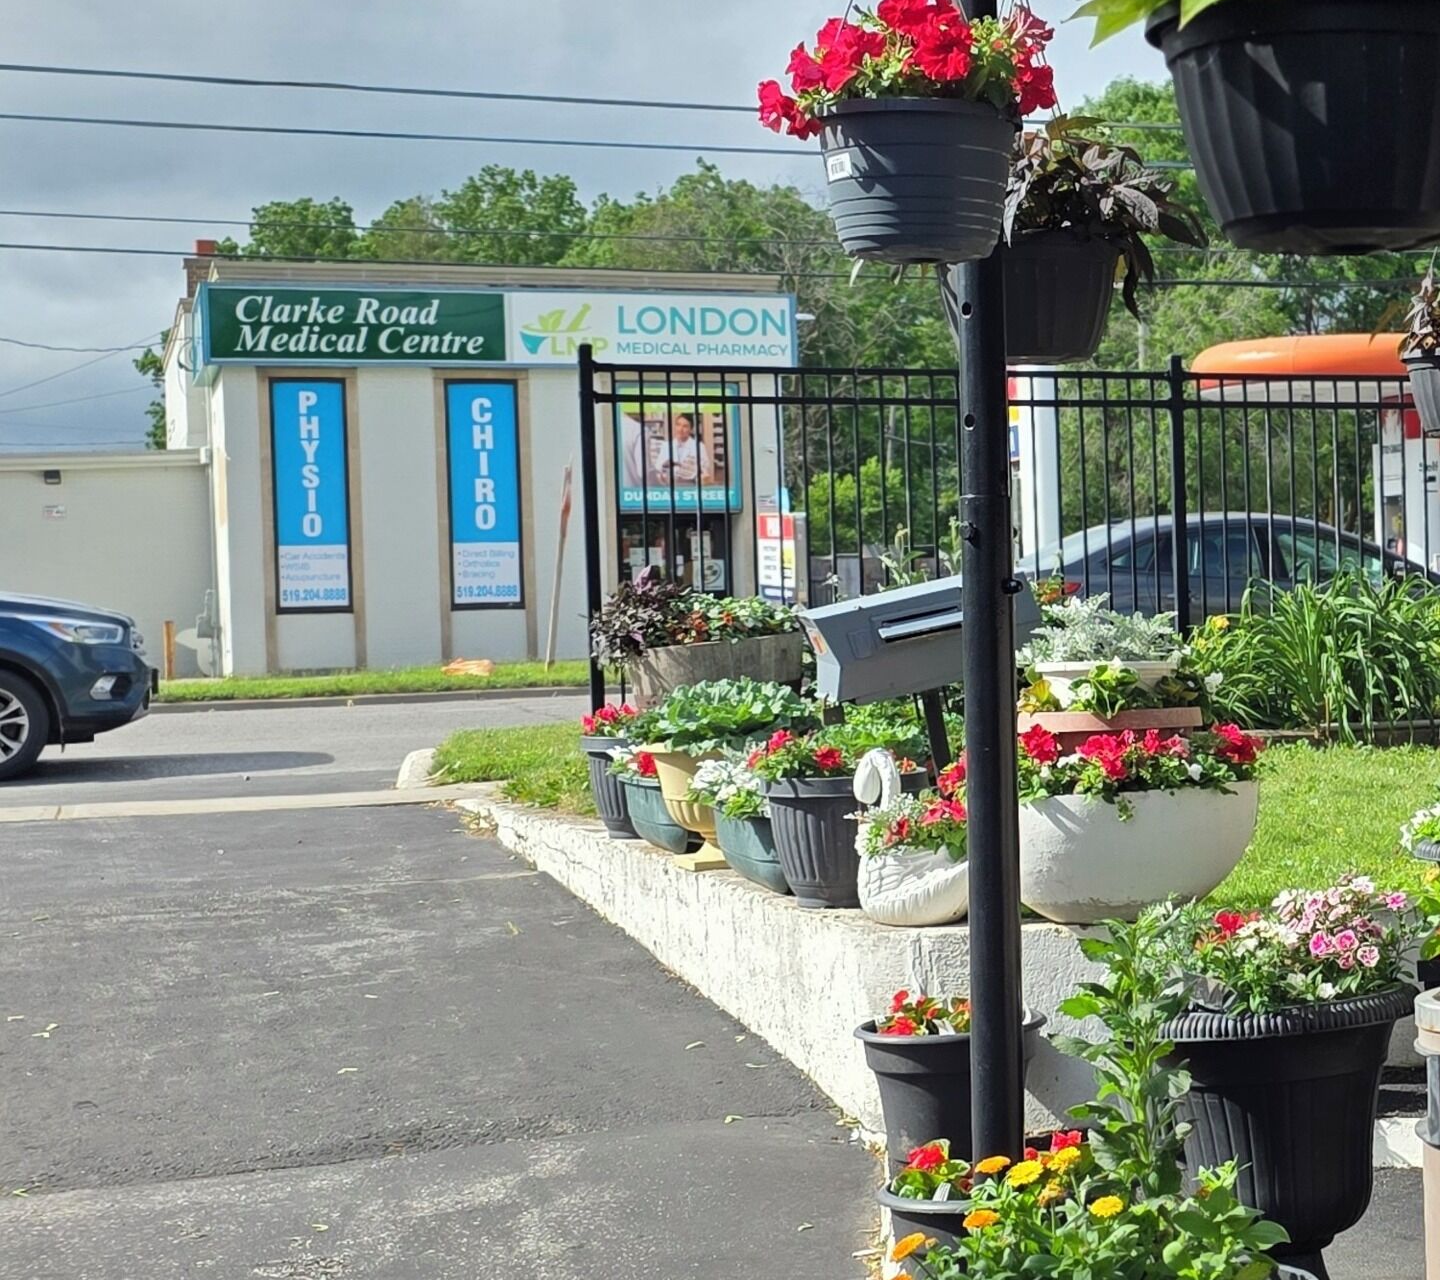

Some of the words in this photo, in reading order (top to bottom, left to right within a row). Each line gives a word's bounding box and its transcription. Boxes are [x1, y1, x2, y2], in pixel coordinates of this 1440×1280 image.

[235, 295, 345, 324] Clarke
[352, 298, 440, 325] Road
[618, 306, 786, 336] LONDON
[233, 325, 369, 353] Medical
[377, 327, 485, 354] Centre
[617, 342, 691, 355] MEDICAL
[697, 343, 788, 356] PHARMACY
[298, 391, 322, 537] PHYSIO
[471, 397, 496, 530] CHIRO
